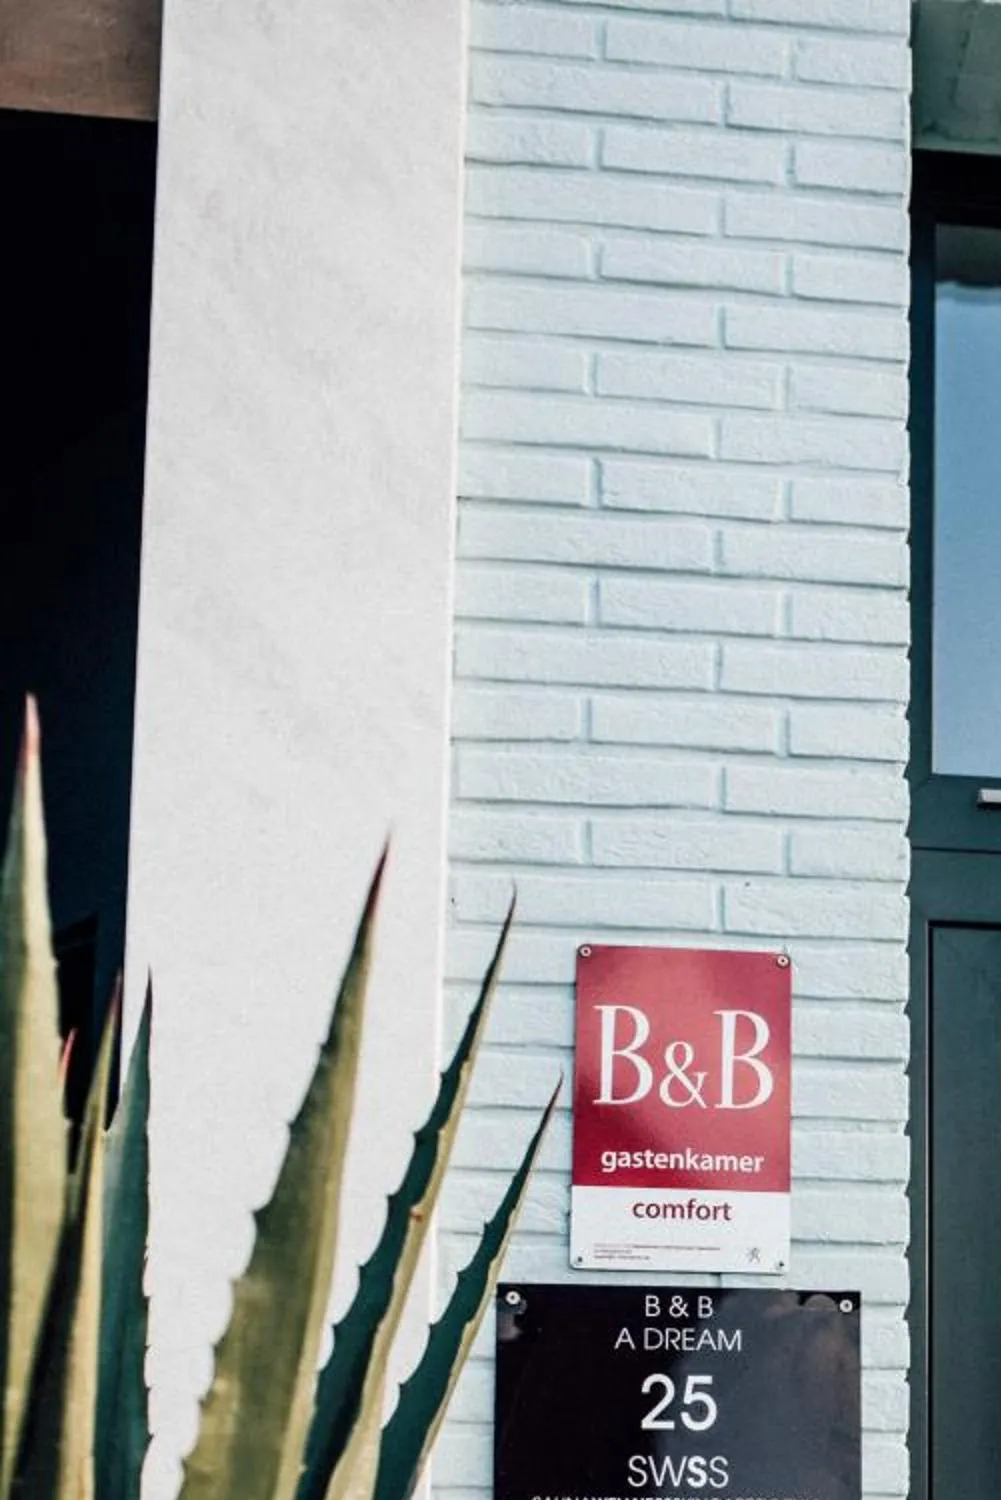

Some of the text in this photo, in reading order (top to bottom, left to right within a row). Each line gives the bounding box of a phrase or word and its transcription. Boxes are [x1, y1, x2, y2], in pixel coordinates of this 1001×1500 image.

[593, 1005, 774, 1110] B&B
[601, 1148, 765, 1173] gastenkamer
[632, 1198, 732, 1221] comfort
[645, 1295, 714, 1318] B & B
[614, 1327, 742, 1351] A DREAM
[640, 1373, 718, 1432] 25
[627, 1454, 729, 1489] SWSS
